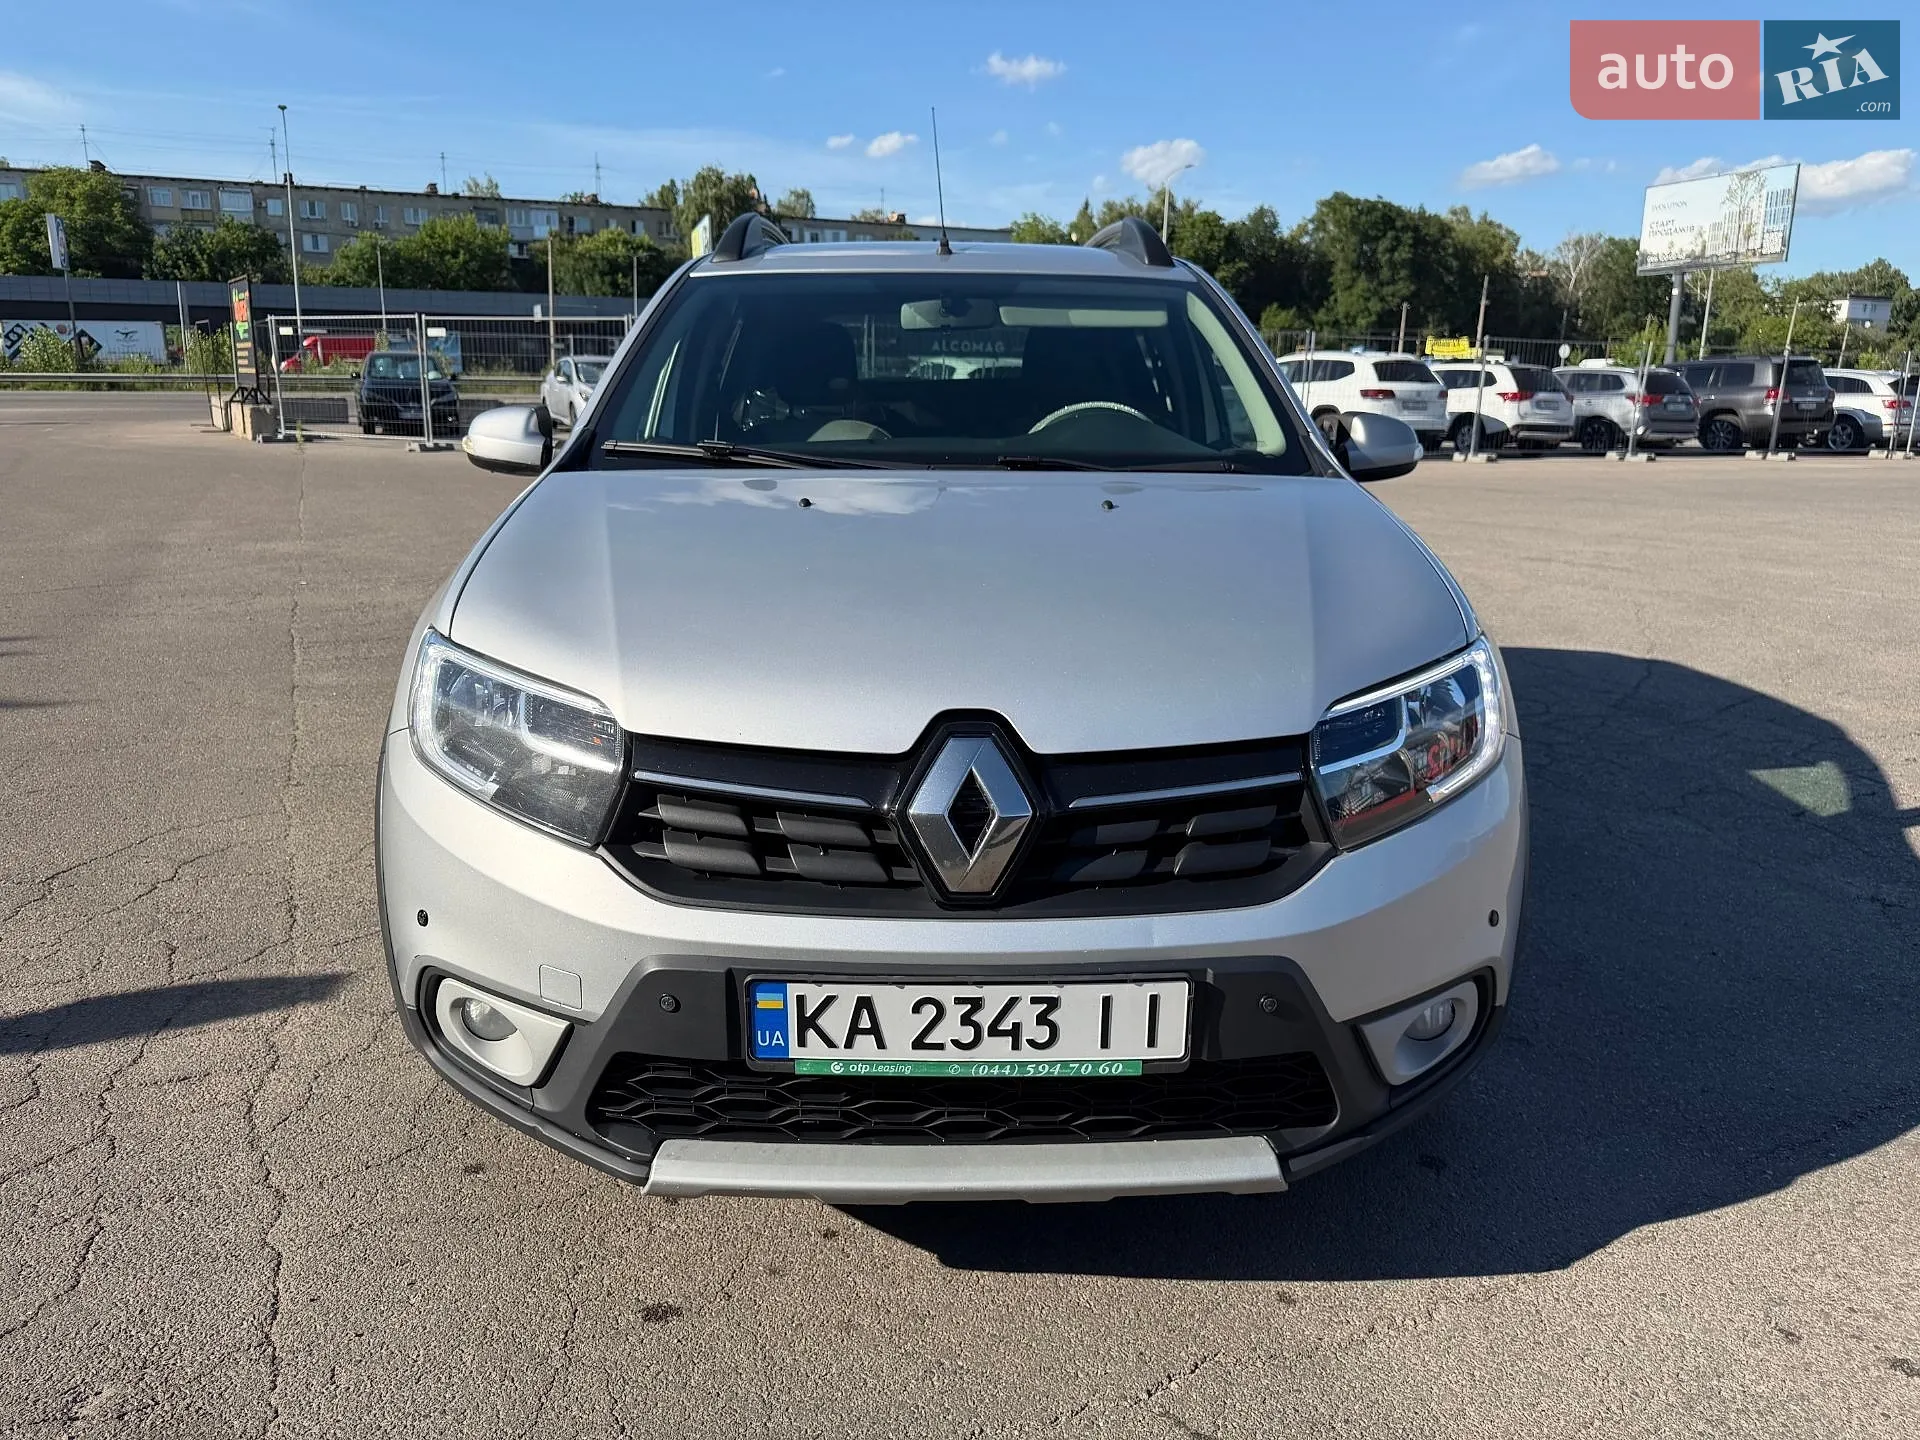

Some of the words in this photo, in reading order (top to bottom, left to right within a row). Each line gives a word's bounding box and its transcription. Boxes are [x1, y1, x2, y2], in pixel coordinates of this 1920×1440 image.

[795, 993, 887, 1050] KA
[910, 995, 1061, 1051] 2343
[757, 1030, 785, 1048] UA
[849, 1063, 870, 1075] otp
[872, 1063, 912, 1075] Leasing
[971, 1063, 1018, 1077] (044)
[1024, 1063, 1061, 1077] 594
[1069, 1063, 1092, 1076] 70
[1098, 1062, 1123, 1075] 60
